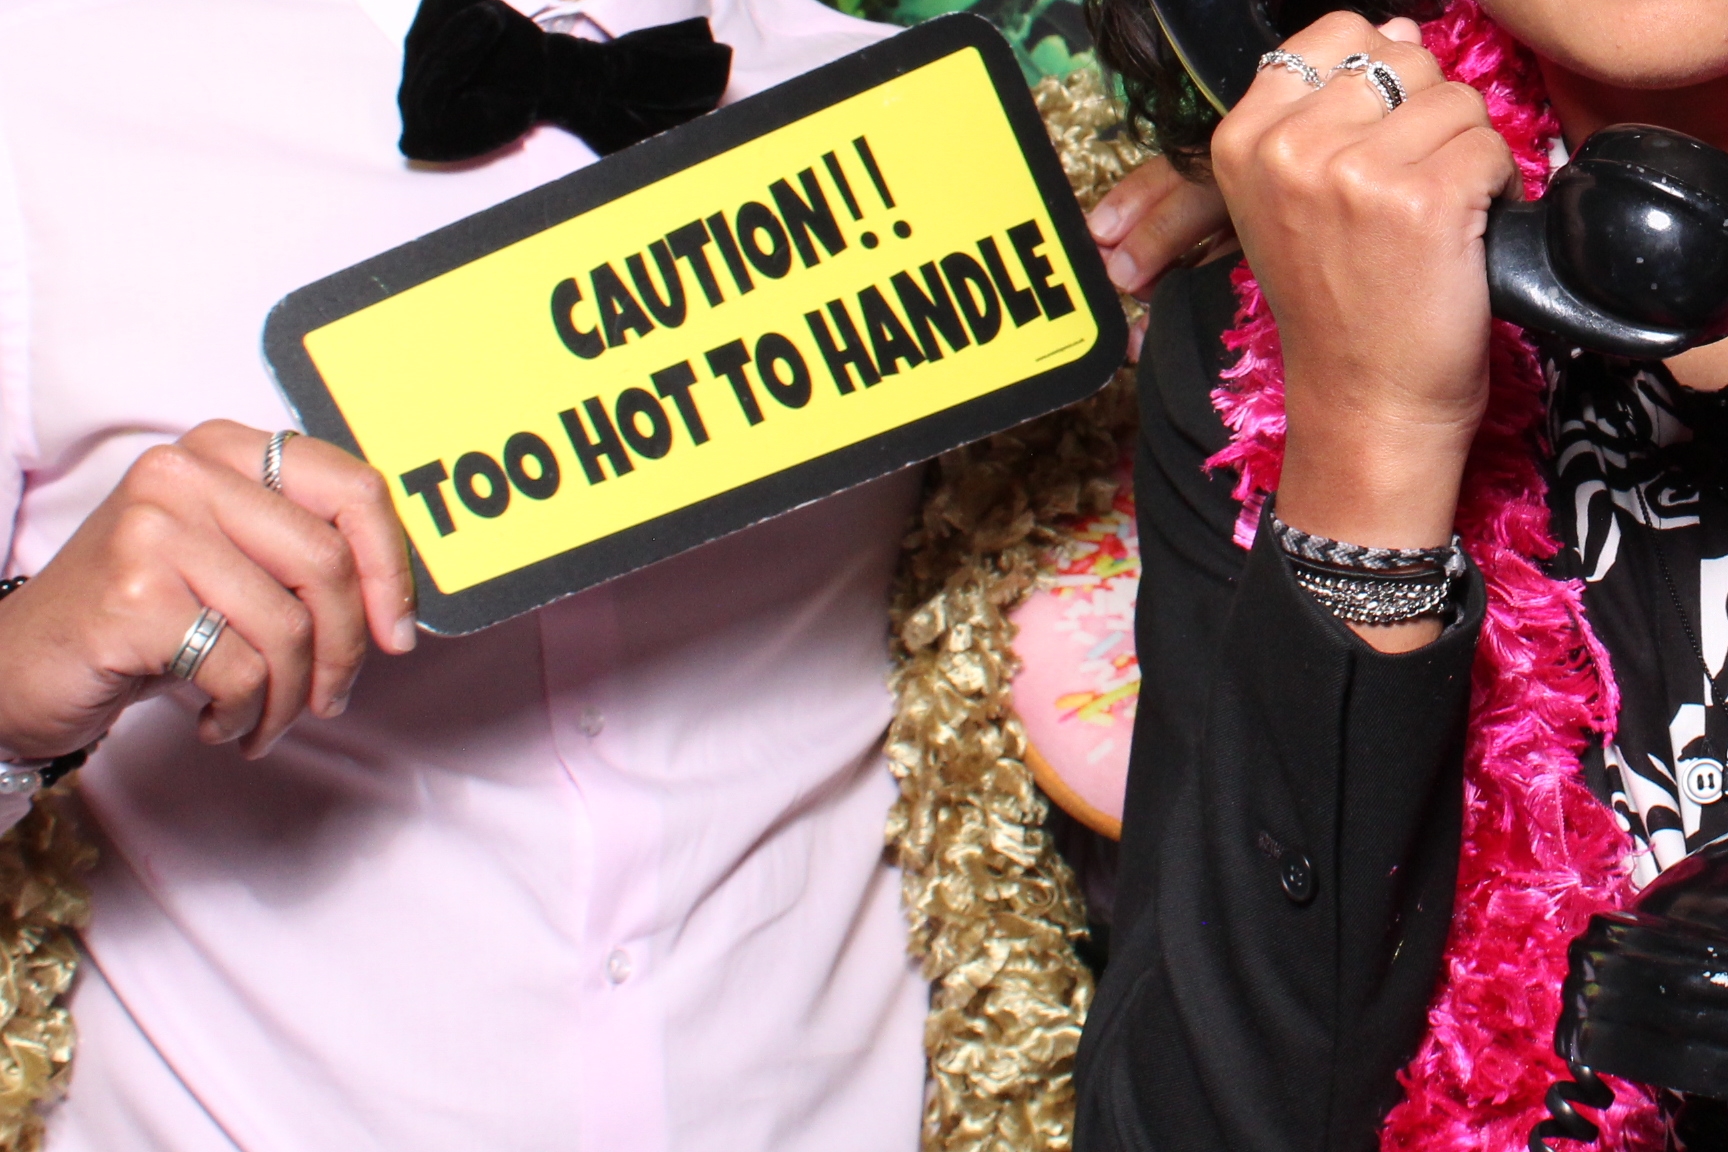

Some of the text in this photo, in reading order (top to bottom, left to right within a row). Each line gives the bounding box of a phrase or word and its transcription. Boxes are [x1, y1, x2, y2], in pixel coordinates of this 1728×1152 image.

[399, 219, 1075, 537] TOO HOT TO HANDLE
[550, 136, 911, 360] CAUTION!!
